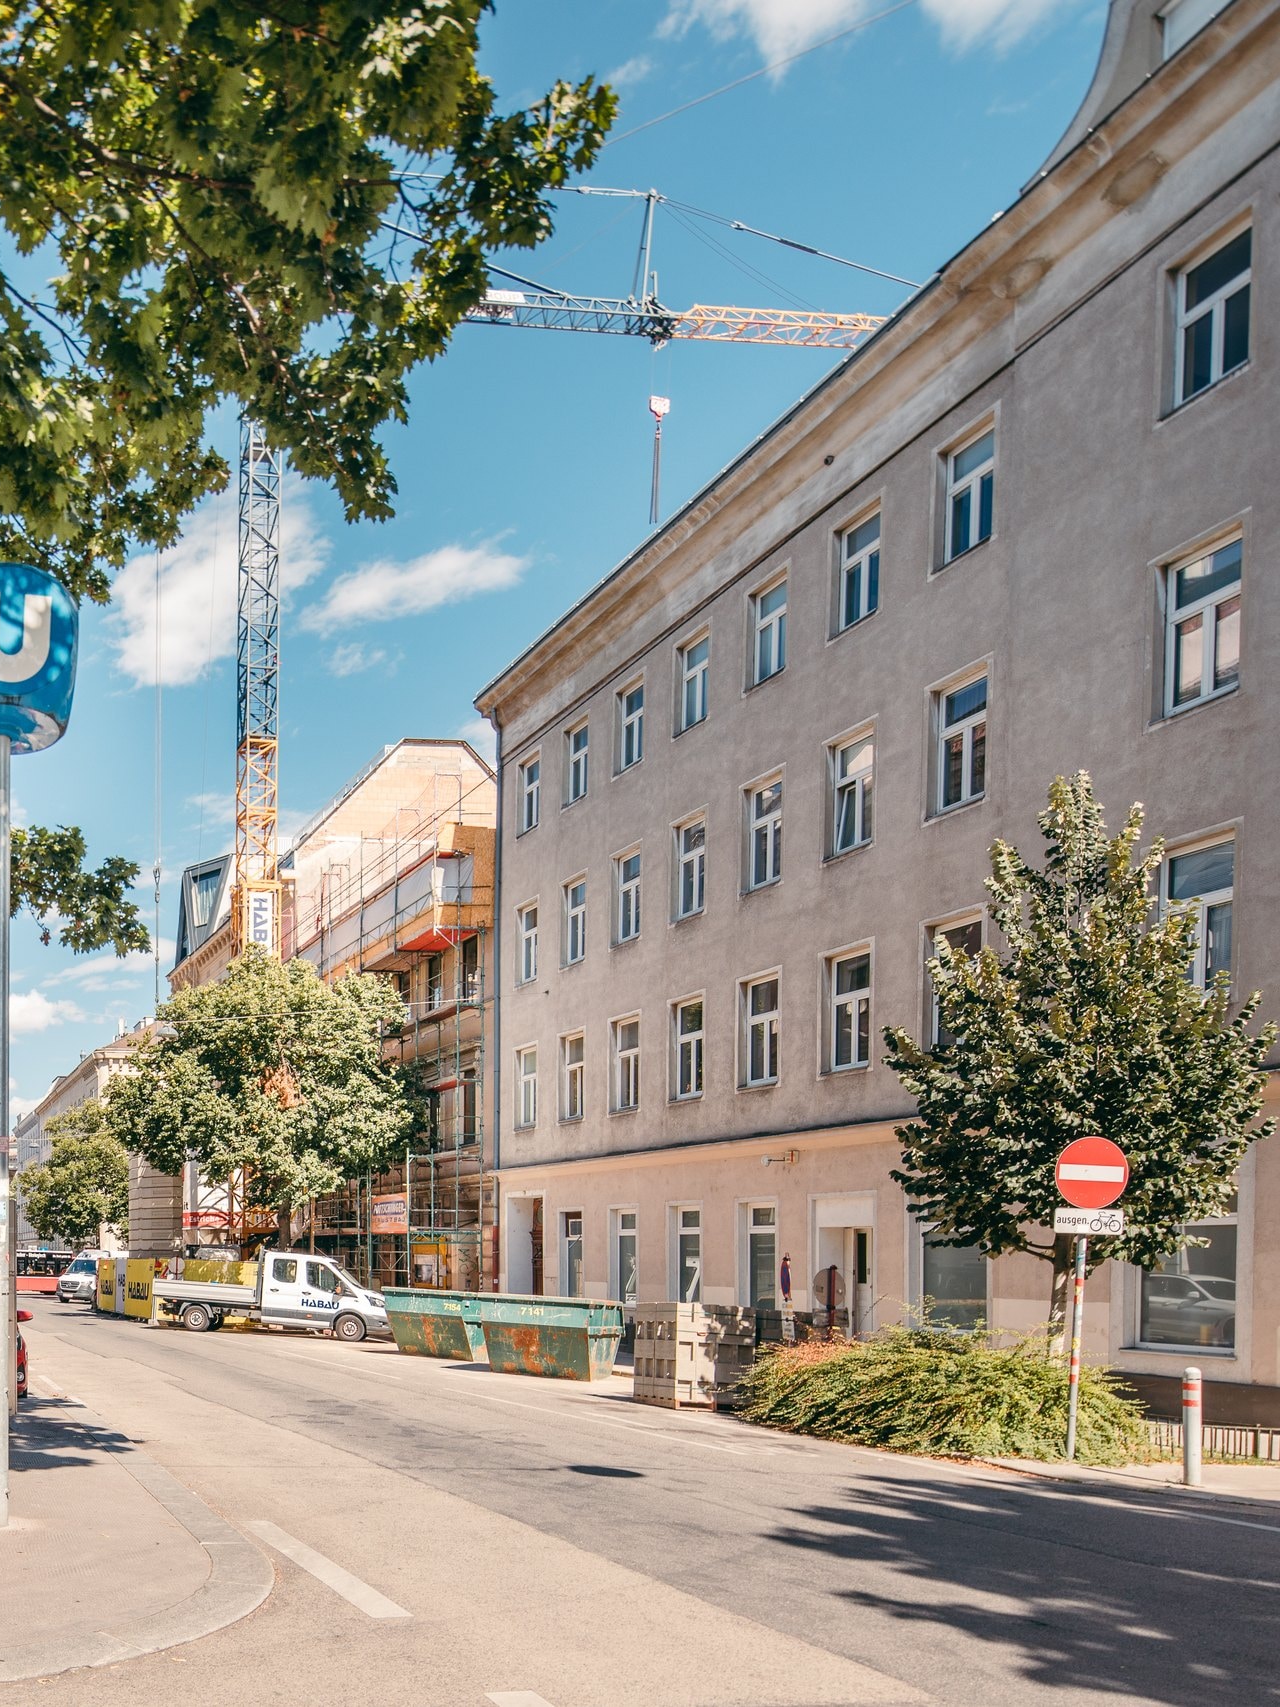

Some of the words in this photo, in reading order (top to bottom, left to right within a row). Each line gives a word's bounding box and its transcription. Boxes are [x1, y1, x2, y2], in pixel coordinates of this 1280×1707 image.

[253, 898, 268, 942] HAB
[1056, 1216, 1090, 1226] ausgen.
[128, 1281, 150, 1301] HABAU
[301, 1298, 340, 1310] HABAU
[443, 1303, 461, 1312] 7154
[520, 1307, 544, 1316] 7141
